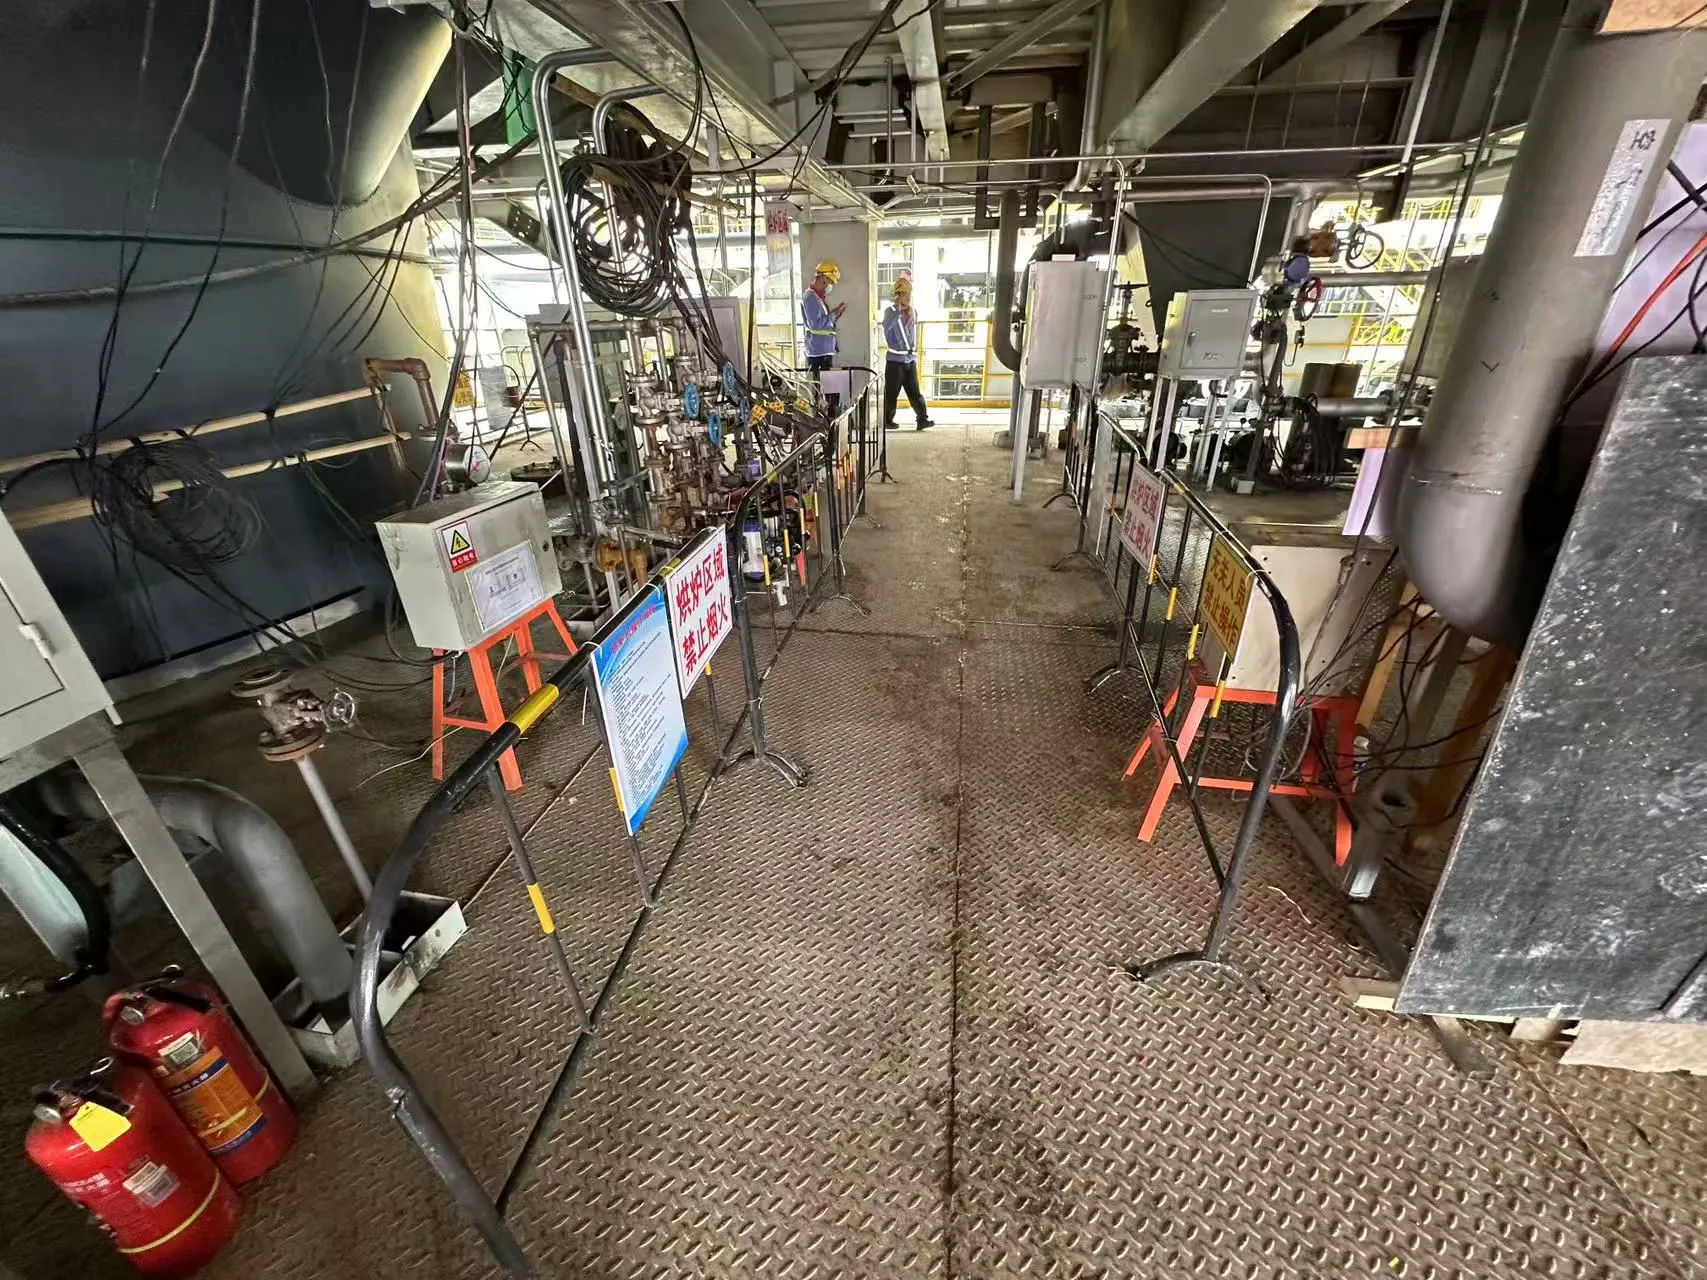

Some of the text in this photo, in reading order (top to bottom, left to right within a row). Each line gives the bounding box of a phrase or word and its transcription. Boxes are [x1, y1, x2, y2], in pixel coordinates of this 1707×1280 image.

[675, 543, 725, 627] 烘炉区域
[1203, 581, 1239, 648] 禁止操作
[1210, 547, 1247, 613] 无关人员
[682, 591, 729, 677] 禁止烟火
